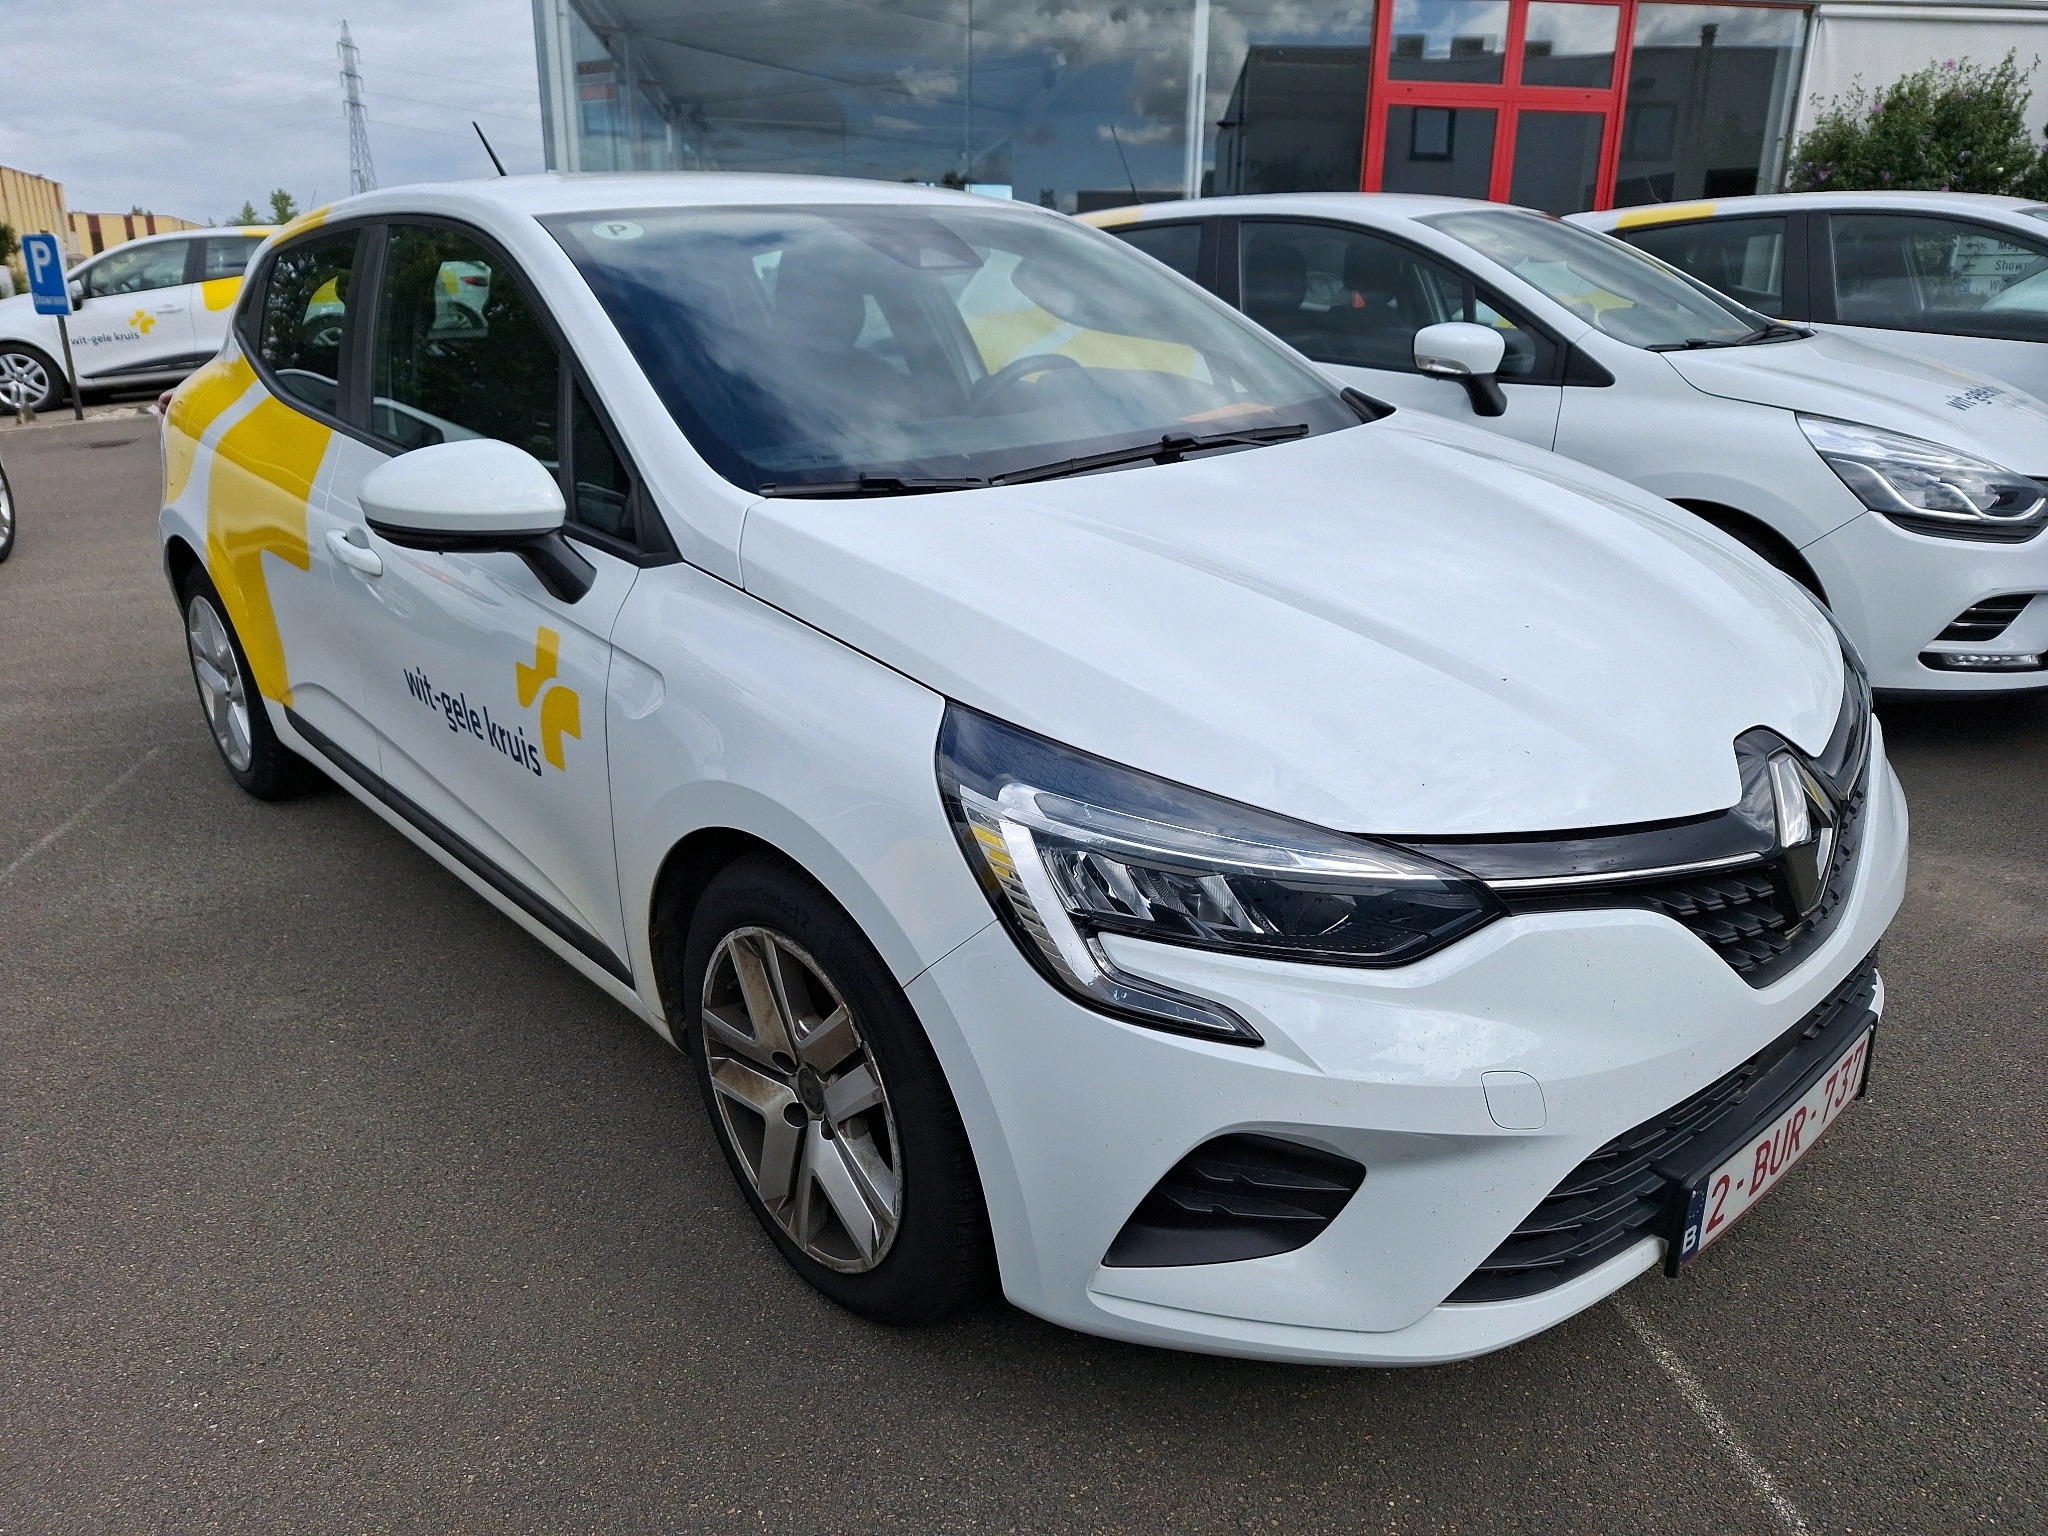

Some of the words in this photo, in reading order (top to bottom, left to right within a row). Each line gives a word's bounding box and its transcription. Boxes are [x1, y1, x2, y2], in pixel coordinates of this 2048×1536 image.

[606, 224, 627, 236] P
[29, 240, 52, 285] P
[70, 333, 112, 346] wit-gele
[113, 331, 140, 341] kruis
[403, 666, 485, 740] wit-gele
[482, 705, 543, 777] kruis
[1682, 1224, 1698, 1255] B
